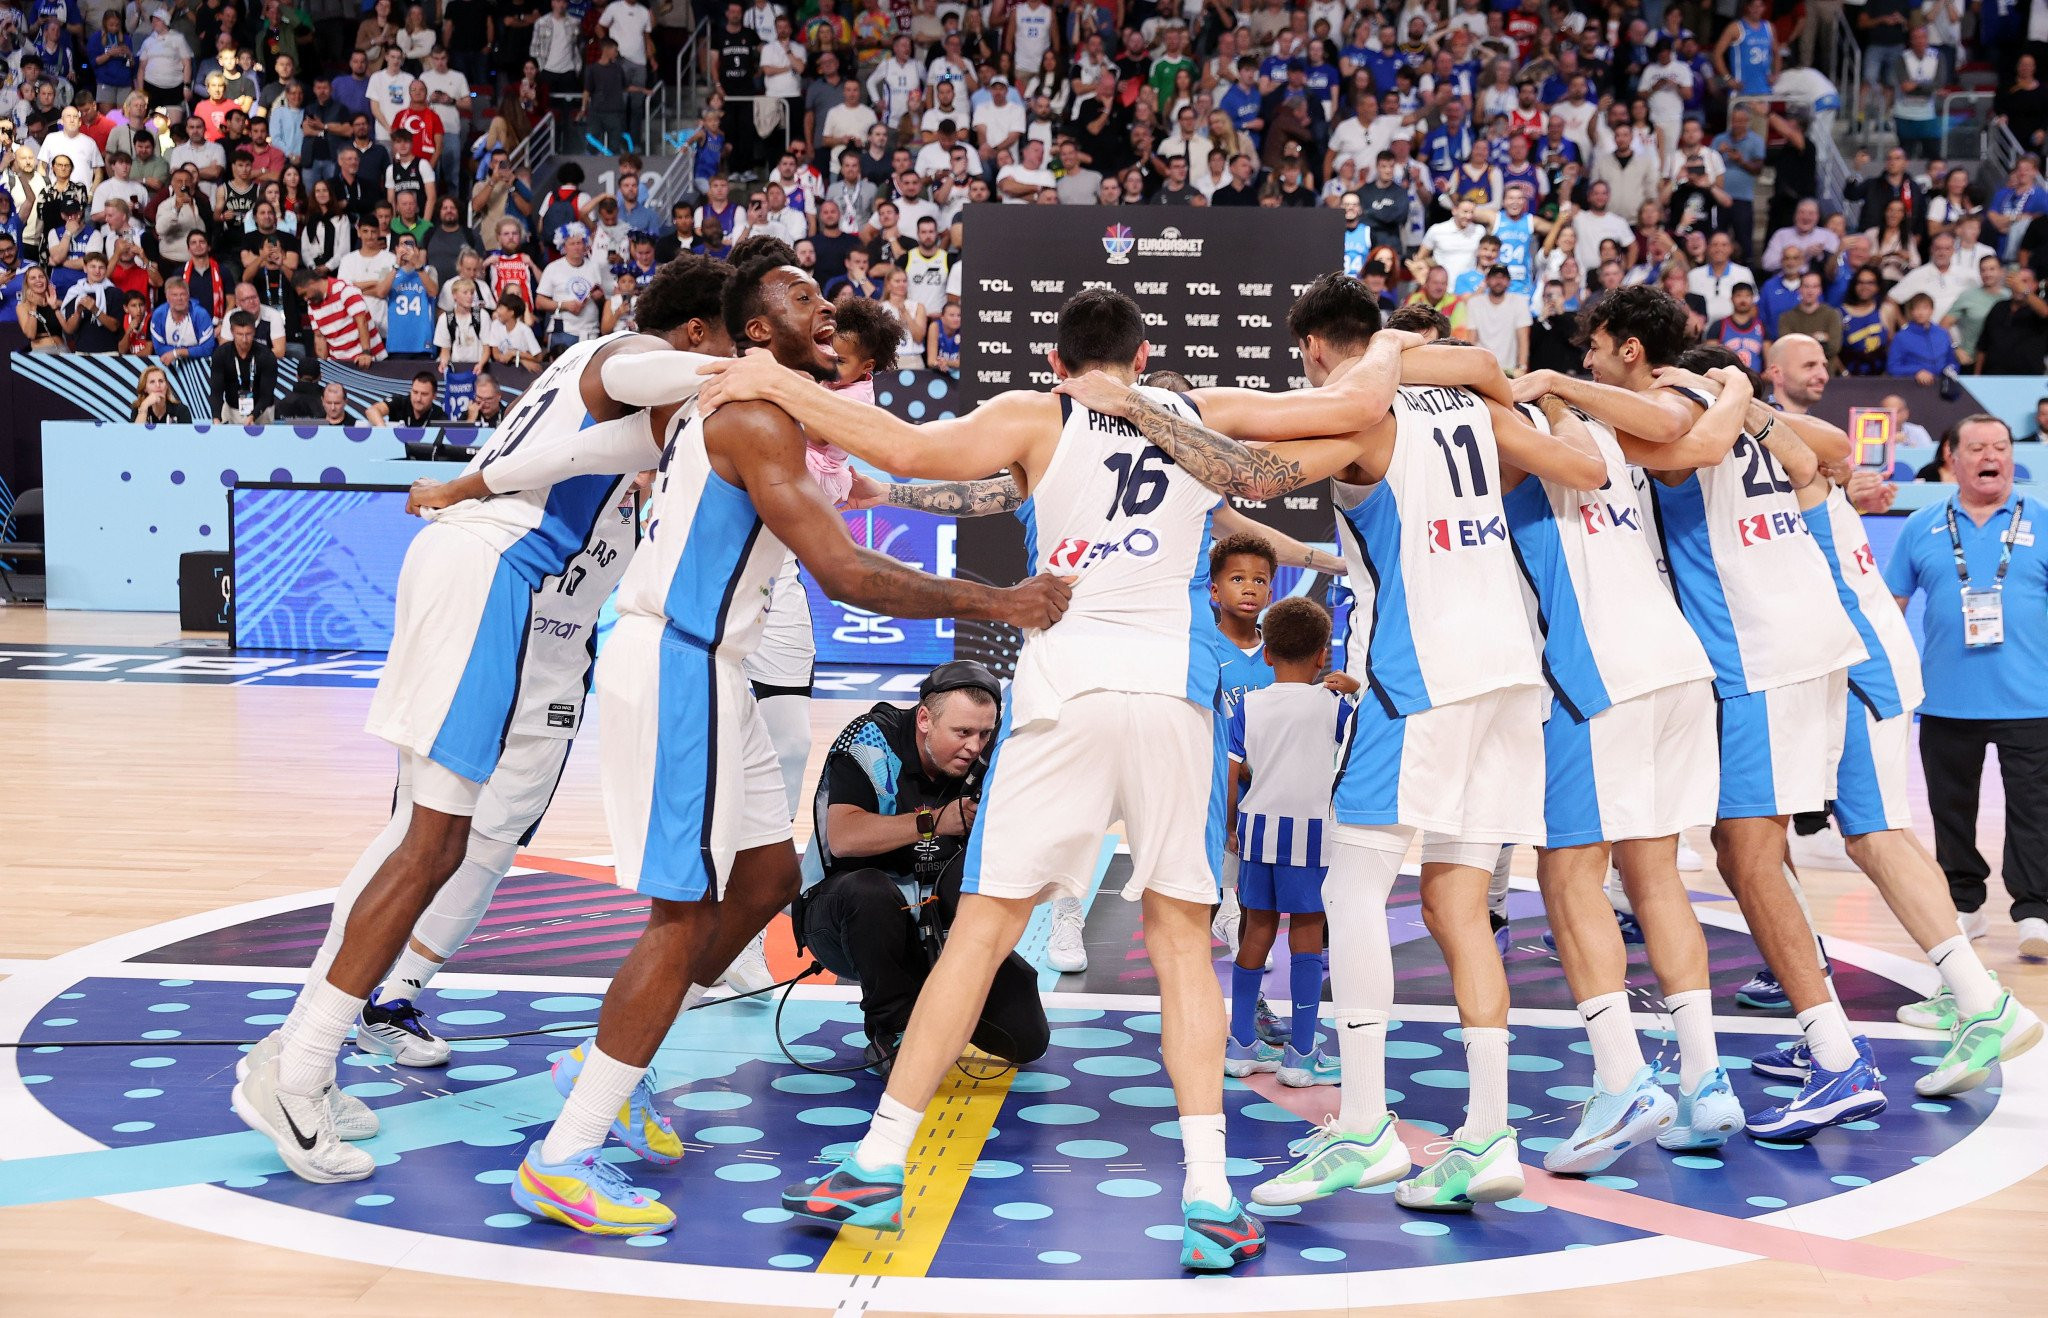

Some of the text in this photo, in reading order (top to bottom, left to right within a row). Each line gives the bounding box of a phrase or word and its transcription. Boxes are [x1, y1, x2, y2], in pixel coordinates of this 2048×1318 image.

[1138, 238, 1204, 251] EUROBASKET
[979, 279, 1014, 292] TCL
[1186, 283, 1221, 296] TCL
[396, 295, 421, 316] 34
[1237, 314, 1273, 328] TCL
[978, 341, 1012, 354] TCL
[1184, 345, 1219, 358] TCL
[1235, 375, 1270, 388] TCL
[1855, 413, 1889, 466] P
[1433, 424, 1488, 497] 11
[1103, 446, 1175, 521] 16
[1232, 496, 1267, 509] TCL
[1458, 515, 1507, 546] EK
[586, 539, 618, 568] AS
